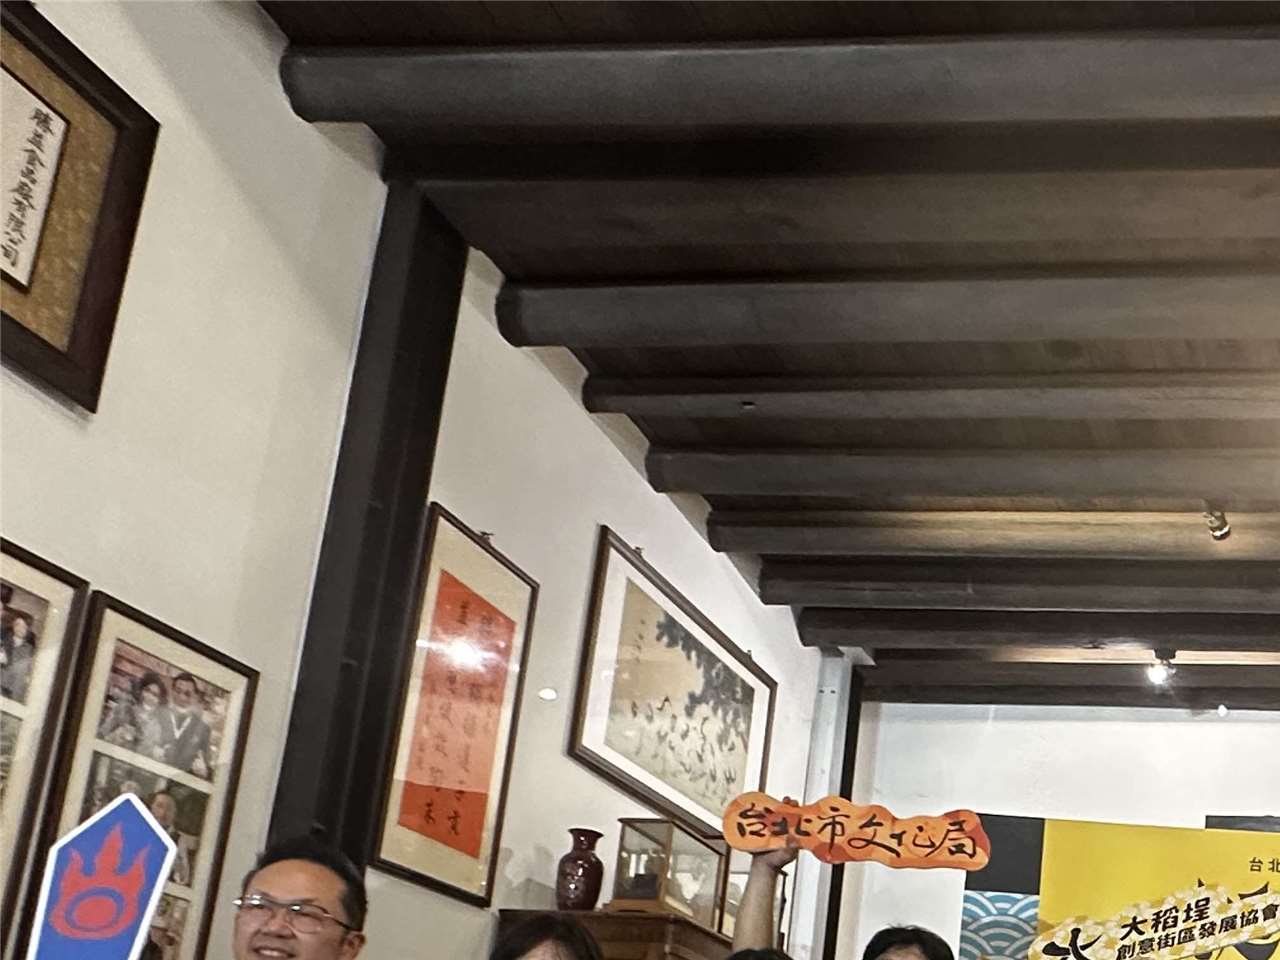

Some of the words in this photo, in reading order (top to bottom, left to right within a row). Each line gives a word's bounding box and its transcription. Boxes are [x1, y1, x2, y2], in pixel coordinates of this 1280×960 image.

[737, 803, 976, 858] 台北市文化局
[1116, 903, 1280, 960] 創意街區發展協會
[1120, 897, 1210, 941] 大稻埕
